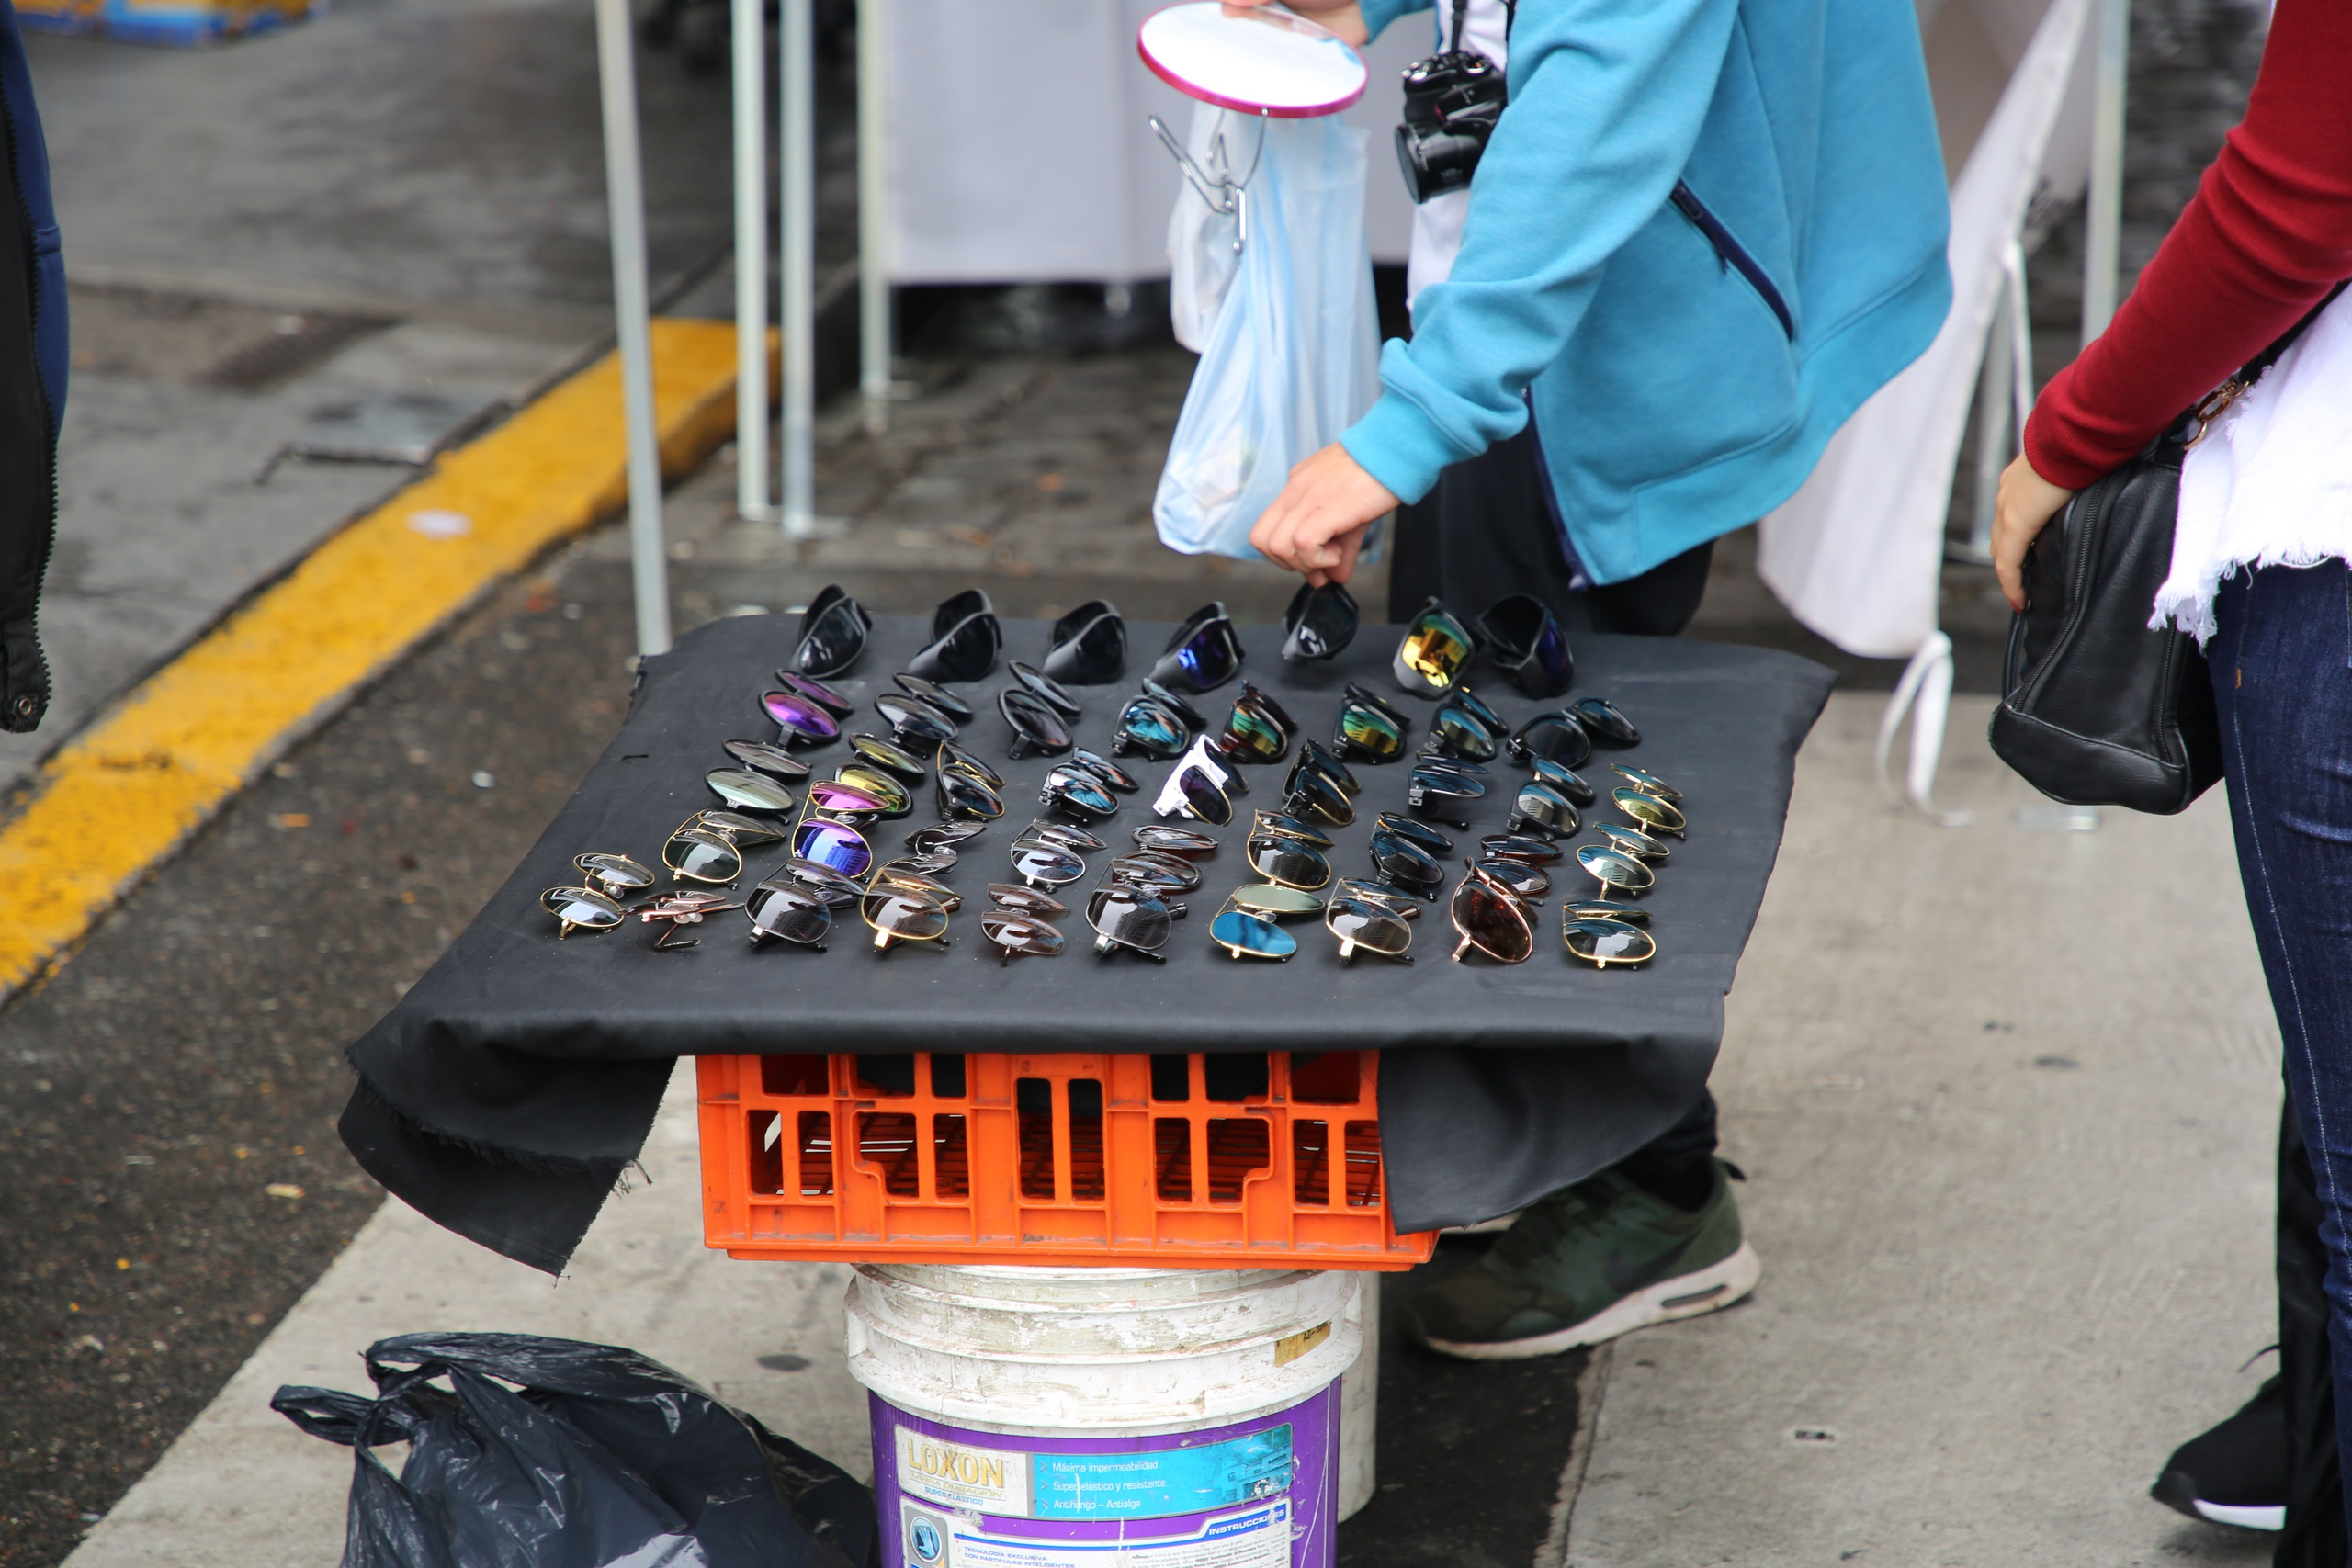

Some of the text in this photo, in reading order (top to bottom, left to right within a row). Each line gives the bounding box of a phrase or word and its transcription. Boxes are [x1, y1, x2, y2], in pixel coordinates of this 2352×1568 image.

[907, 1438, 1004, 1488] LOXON
[1088, 1461, 1159, 1473] impermeabilidad
[1115, 1483, 1121, 1492] y
[1123, 1480, 1166, 1491] resistente
[1105, 1499, 1141, 1509] Antialga
[1208, 1508, 1285, 1536] INSTRUCCIOES
[964, 1552, 979, 1561] CON
[1007, 1551, 1047, 1562] EXCLUSIVA
